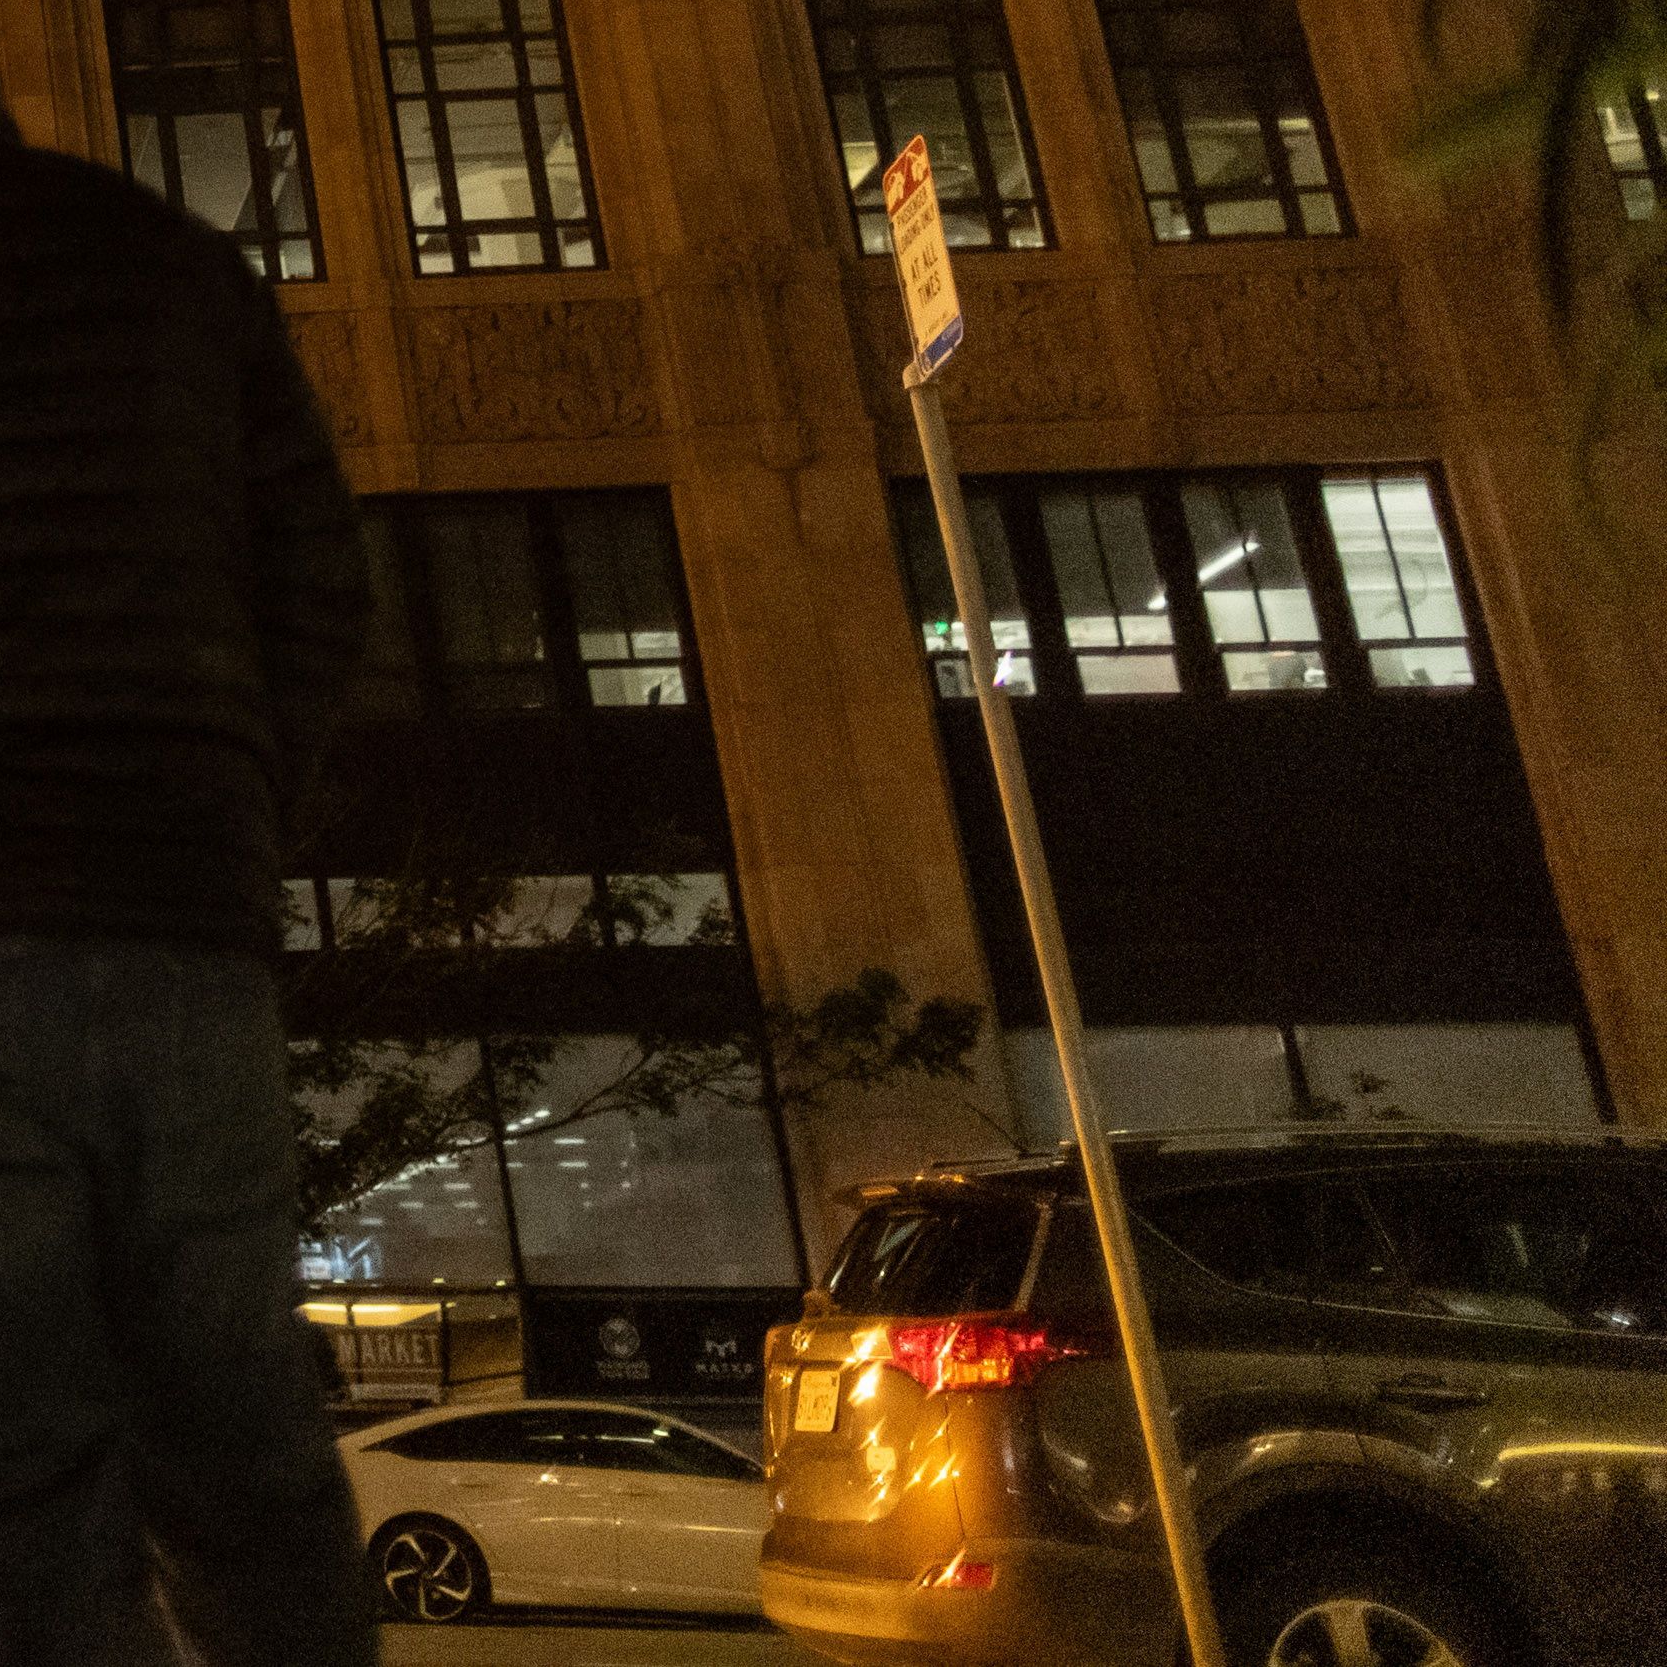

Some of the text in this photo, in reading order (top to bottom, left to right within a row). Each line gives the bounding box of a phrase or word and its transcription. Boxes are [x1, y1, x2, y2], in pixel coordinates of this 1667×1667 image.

[911, 241, 939, 283] AT ALL
[917, 270, 941, 309] TIMES
[337, 1334, 439, 1364] MARKET
